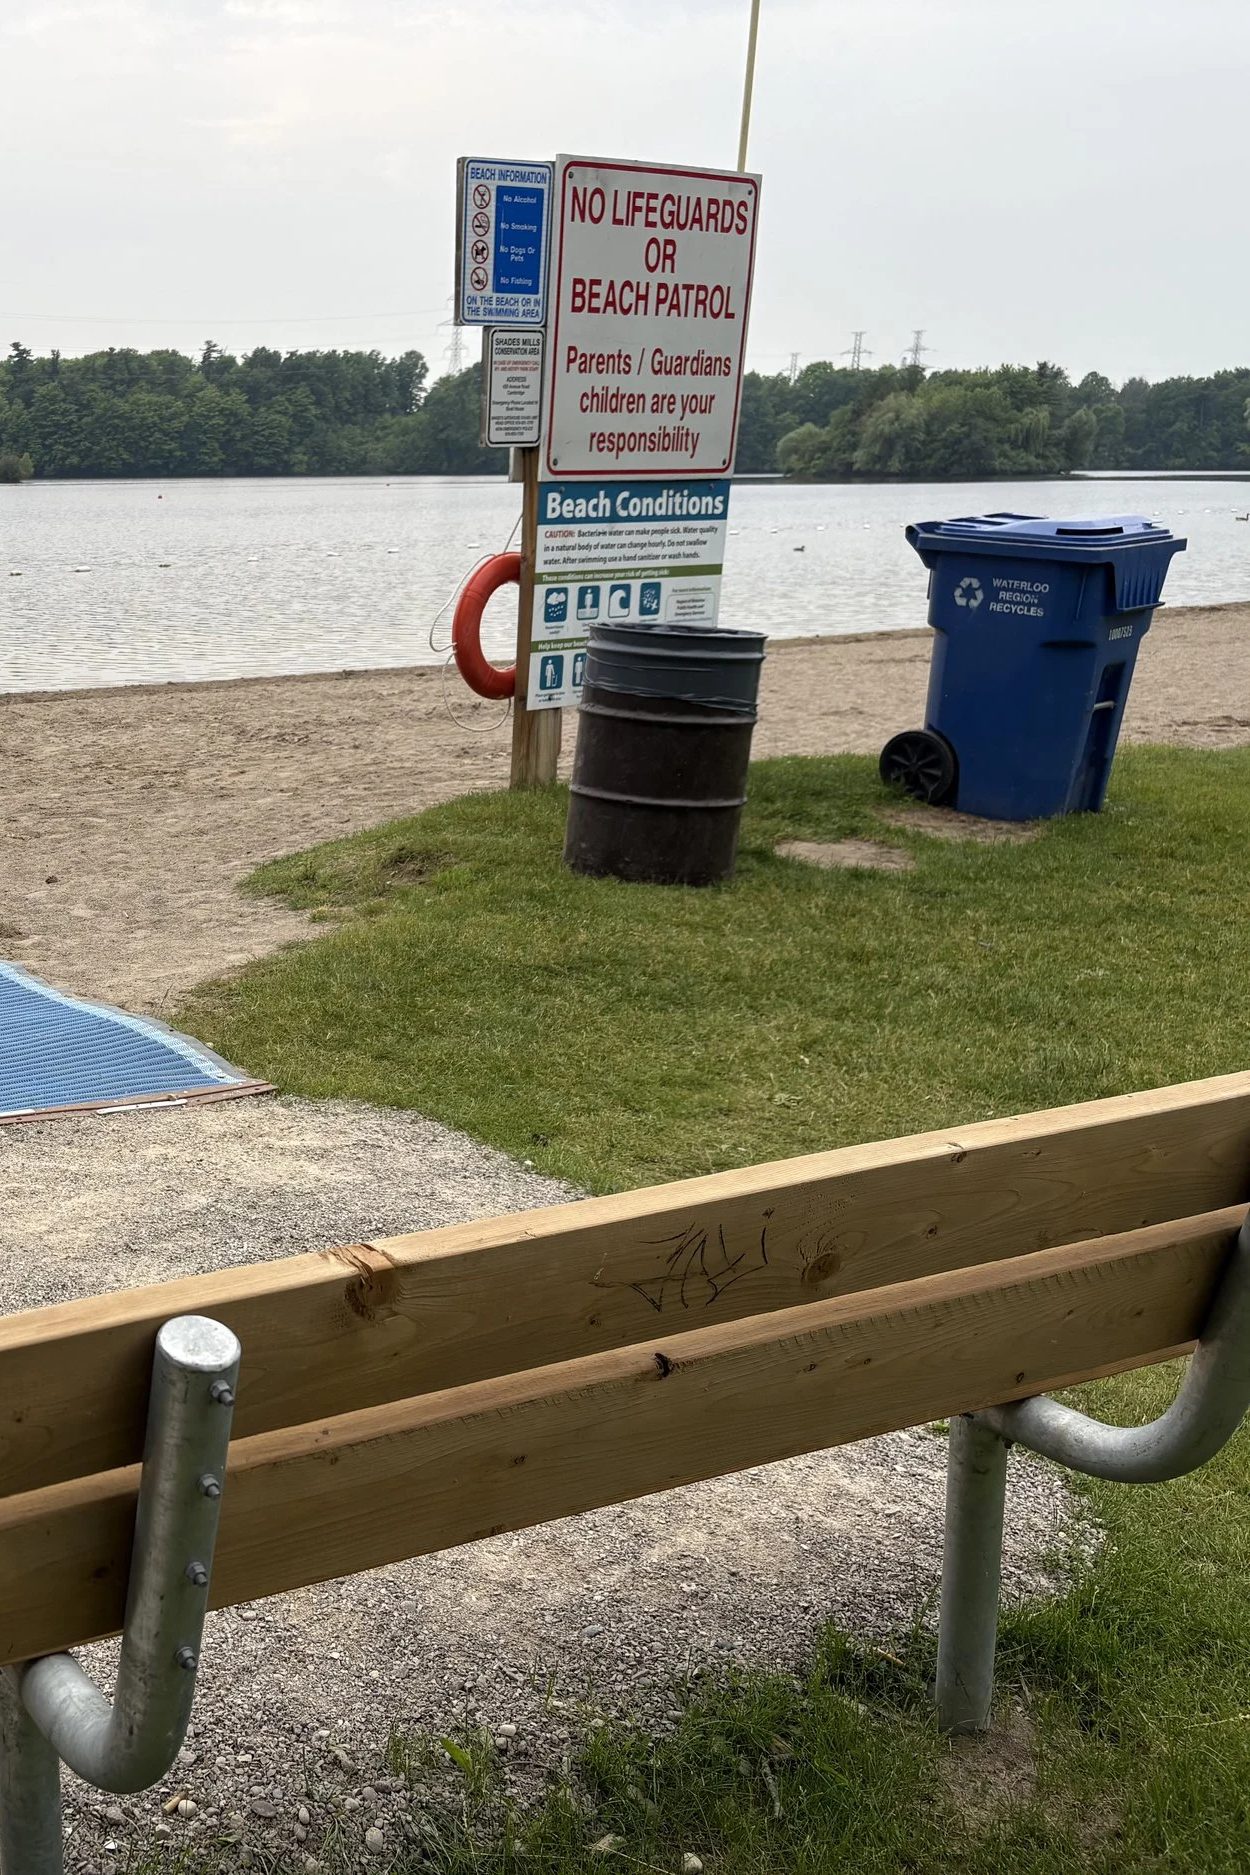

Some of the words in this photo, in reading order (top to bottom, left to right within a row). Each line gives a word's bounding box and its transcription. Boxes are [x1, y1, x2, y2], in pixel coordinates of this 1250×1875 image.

[470, 167, 496, 180] BEACH
[497, 169, 547, 184] INFORMATION
[513, 195, 536, 203] Alcohol
[570, 186, 606, 225] NO
[611, 189, 749, 235] LIFEGUARDS
[500, 222, 509, 230] No
[511, 223, 537, 232] Smoking
[510, 246, 526, 254] Dogs
[644, 237, 677, 274] OR
[510, 277, 532, 286] Fishing
[466, 296, 477, 305] ON
[479, 296, 493, 306] THE
[495, 297, 519, 306] BEACH
[521, 297, 532, 307] OR
[533, 298, 540, 307] IN
[570, 277, 650, 316] BEACH
[654, 282, 735, 319] PATROL
[467, 306, 480, 316] THE
[483, 307, 519, 317] SWIMMING
[521, 309, 540, 318] AREA
[495, 338, 520, 346] SHADES
[521, 338, 540, 346] MILLS
[494, 347, 528, 355] CONSERVATION
[528, 347, 540, 355] AREA
[566, 345, 632, 375] Parents
[636, 347, 645, 375] /
[650, 347, 732, 377] Guardians
[579, 385, 646, 414] children
[650, 392, 676, 414] are
[679, 392, 715, 421] your
[588, 425, 700, 460] responsibility
[546, 490, 611, 518] Beach
[615, 489, 724, 517] Conditions
[544, 530, 575, 538] CAUTION:
[650, 527, 669, 536] people
[699, 525, 718, 535] quality
[543, 544, 550, 552] in
[555, 543, 576, 552] natural
[577, 542, 592, 552] body
[592, 542, 600, 550] of
[627, 541, 647, 550] change
[685, 538, 707, 546] swallow
[543, 557, 561, 566] water.
[561, 556, 577, 564] After
[577, 555, 607, 564] swimming
[637, 553, 660, 561] sanitizer
[542, 574, 557, 582] These
[557, 572, 583, 580] conditions
[992, 577, 1050, 592] WATERLOO
[999, 591, 1039, 604] REGION
[989, 602, 1044, 617] RECYCLES
[538, 642, 550, 650] Help
[550, 642, 563, 651] keep
